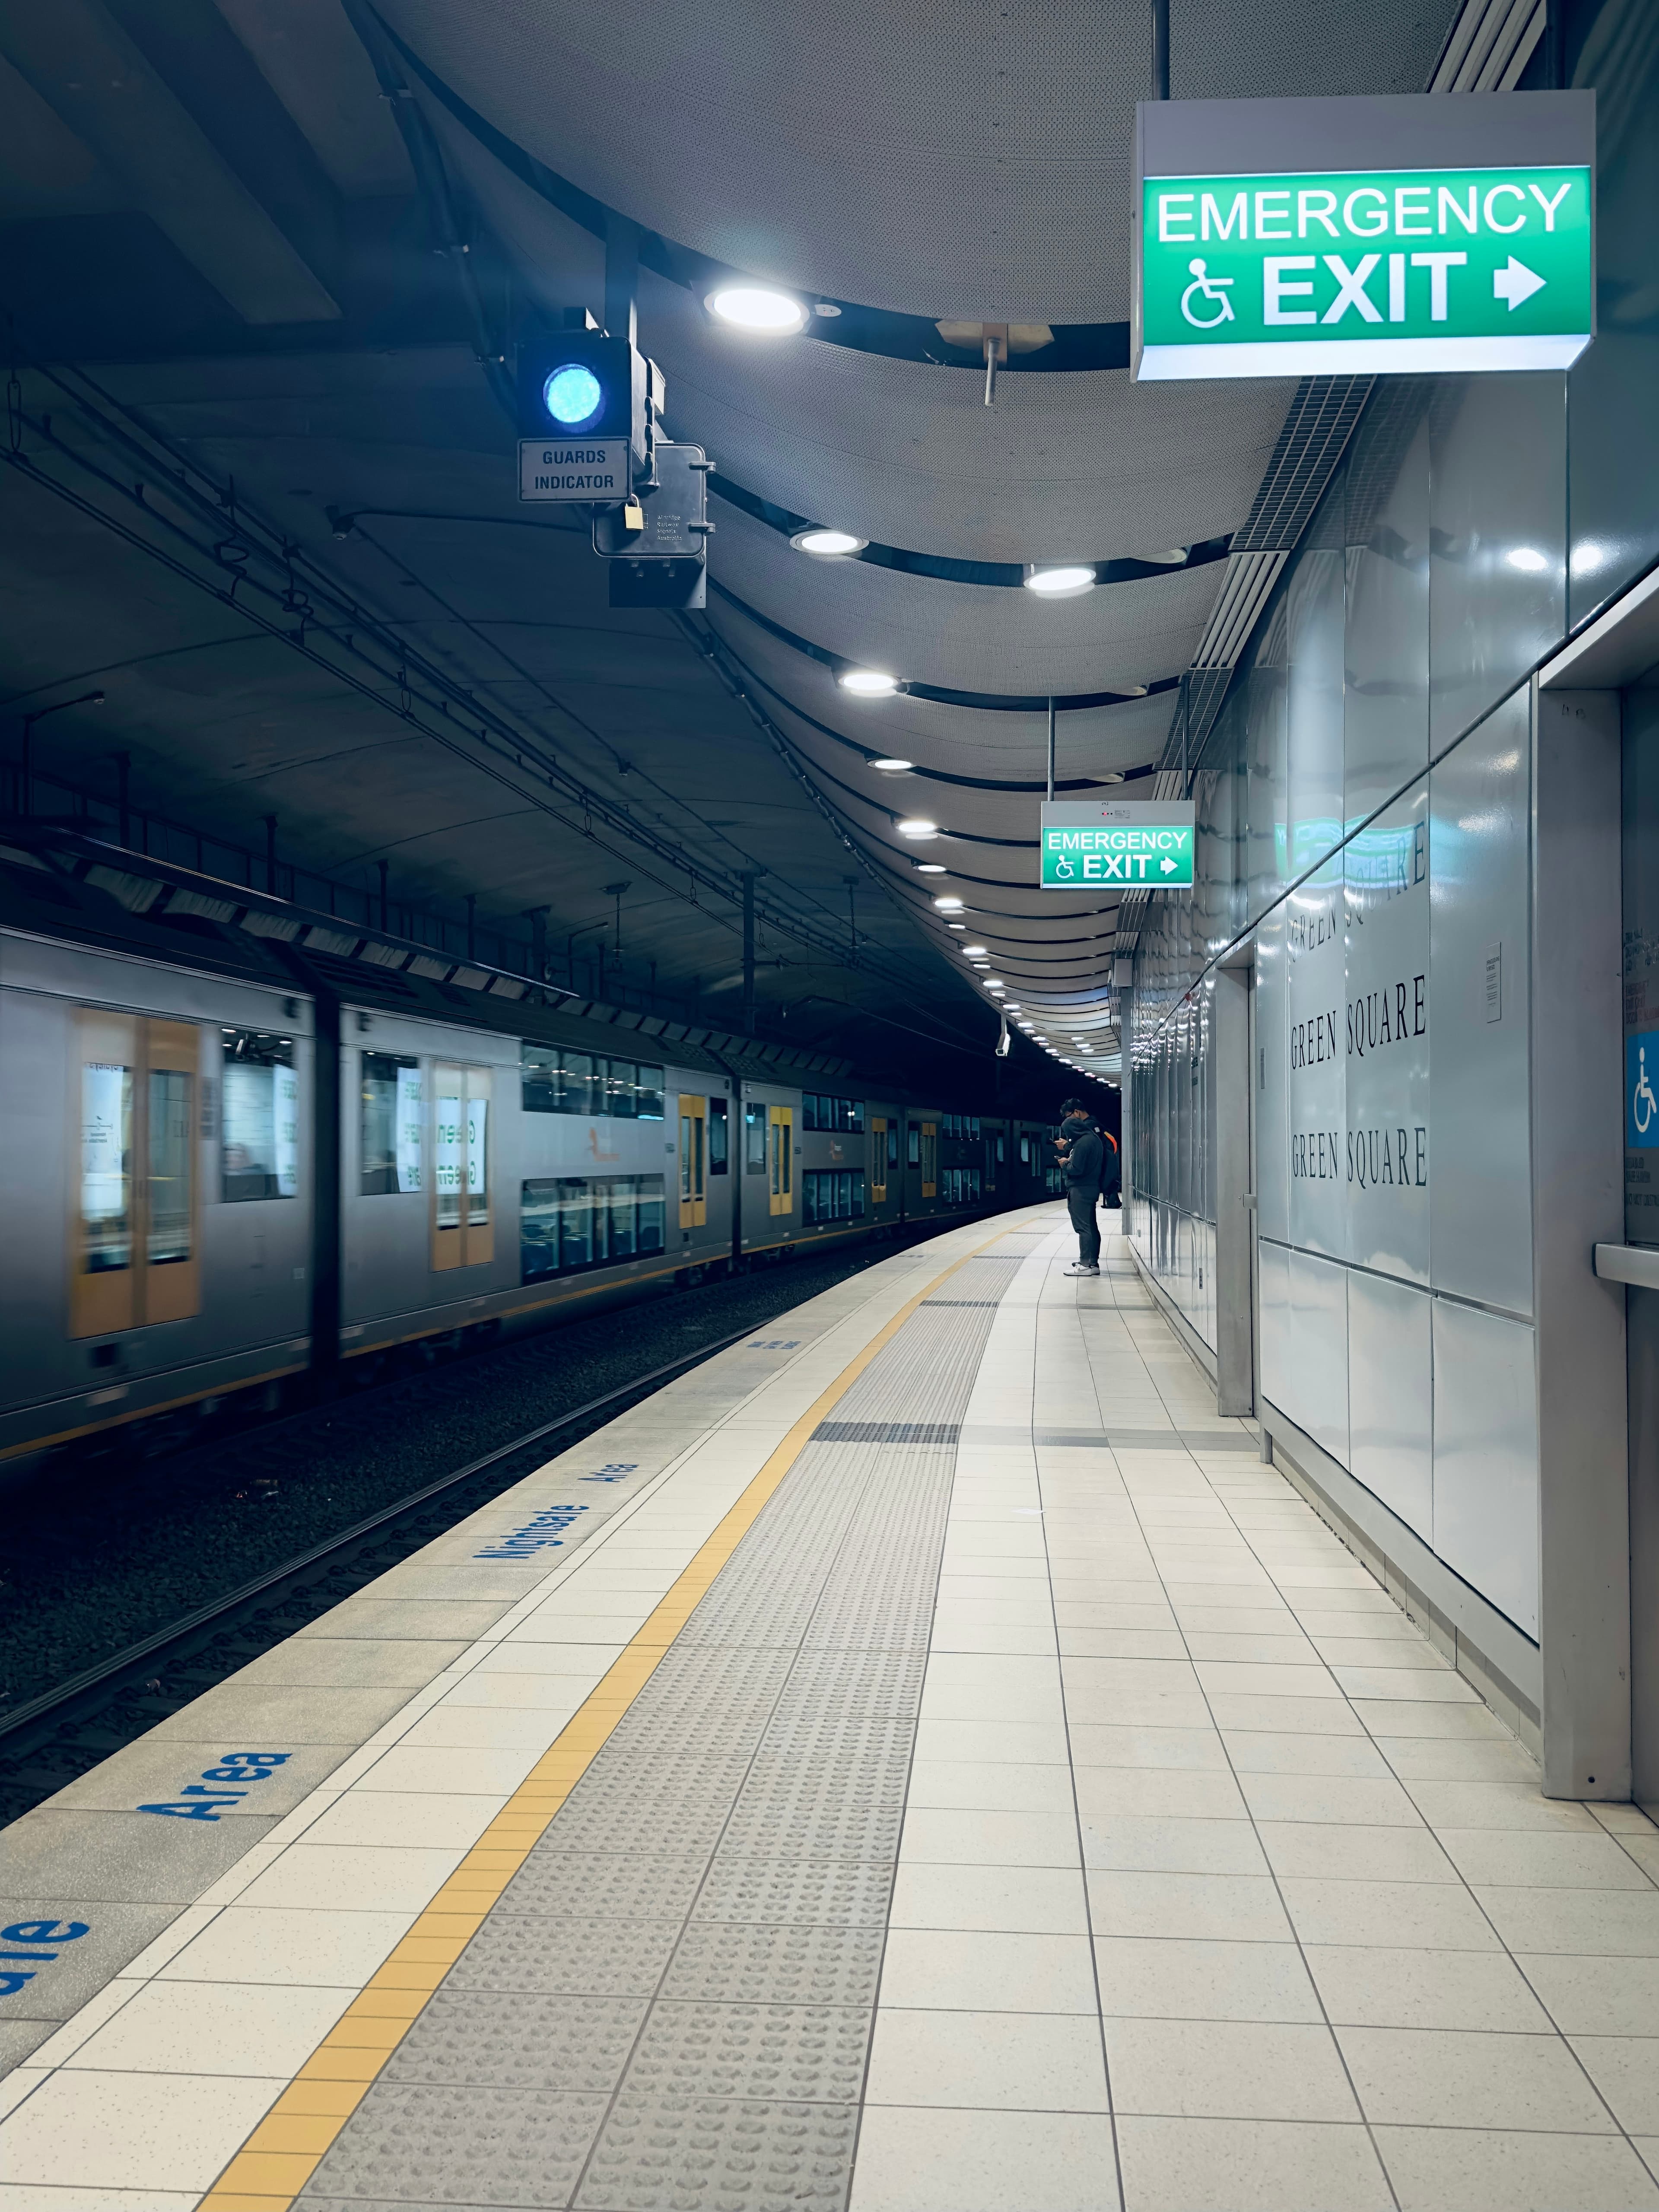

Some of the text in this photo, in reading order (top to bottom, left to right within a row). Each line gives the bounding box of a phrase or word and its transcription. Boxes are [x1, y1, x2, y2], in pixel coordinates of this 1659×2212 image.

[1158, 183, 1572, 242] EMERGENCY
[1263, 252, 1467, 325] EXIT
[535, 475, 614, 489] INDICATOR
[543, 450, 606, 464] GUARDS
[1048, 832, 1187, 849] EMERGENCY
[1083, 855, 1152, 878] EXIT
[1291, 1010, 1336, 1070] GREEN
[1347, 974, 1426, 1057] SQUARE
[1293, 1127, 1427, 1189] GREEN SQUARE
[472, 1464, 639, 1559] Nightsafe Area
[136, 1752, 293, 1821] Area
